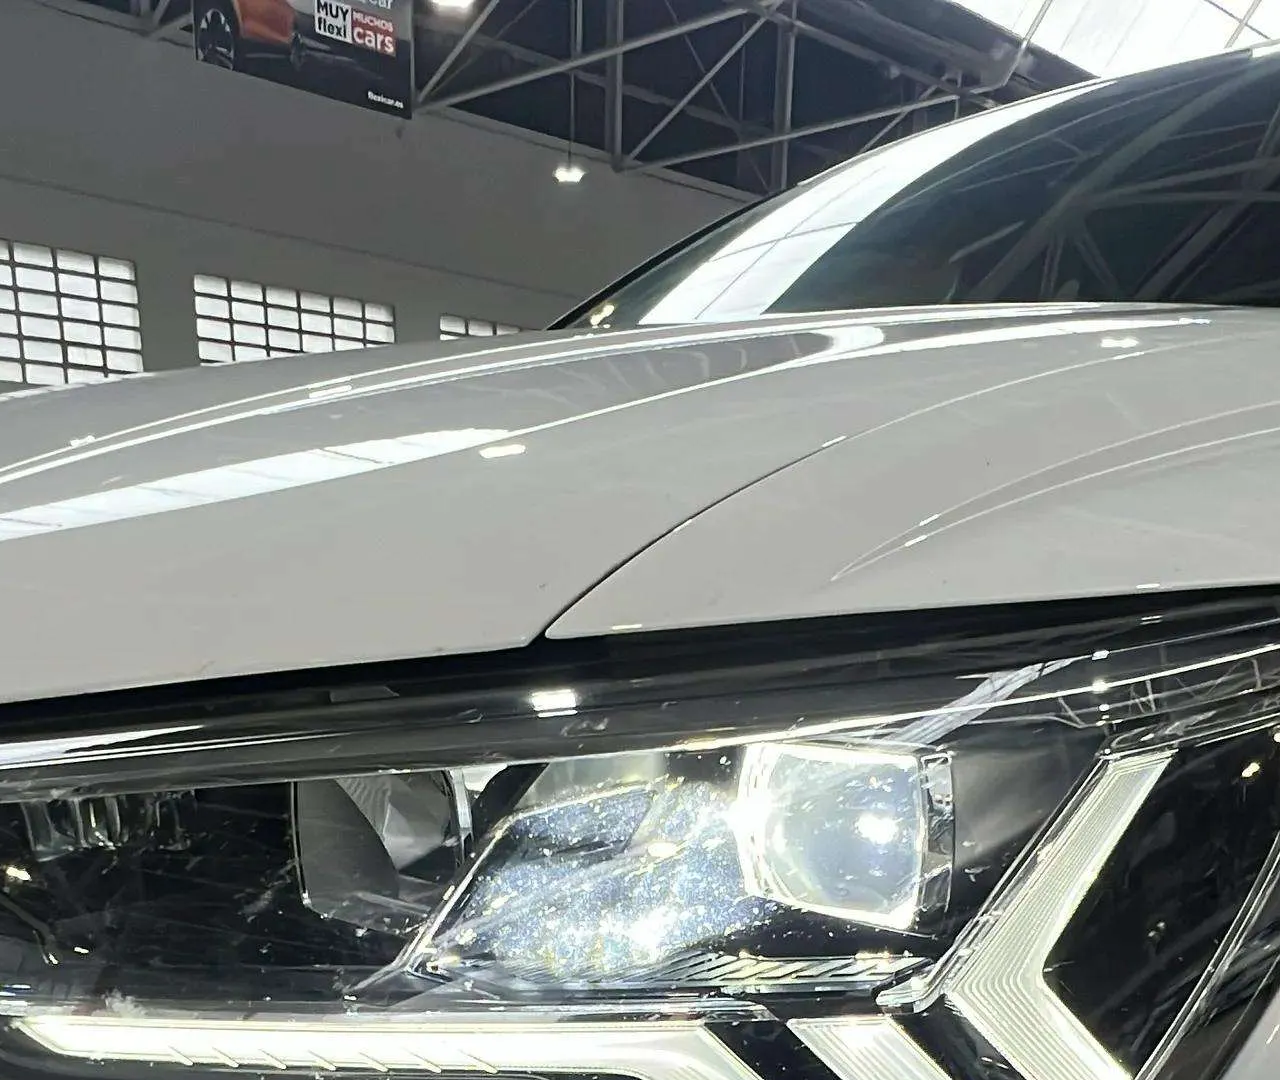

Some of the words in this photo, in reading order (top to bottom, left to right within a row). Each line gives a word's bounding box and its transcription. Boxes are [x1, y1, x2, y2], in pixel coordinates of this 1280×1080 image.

[317, 0, 349, 21] MUY
[318, 17, 348, 38] flexi
[353, 11, 394, 32] MUCHOS
[353, 27, 395, 53] cars
